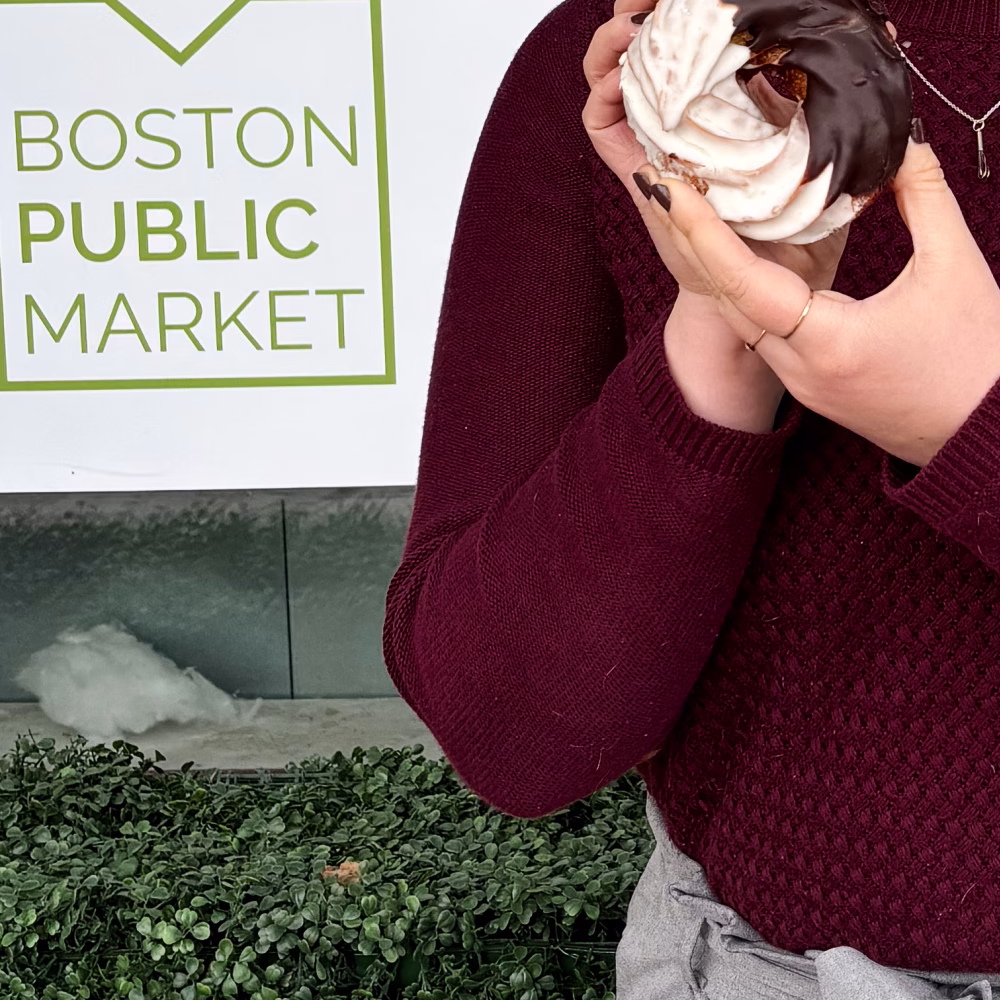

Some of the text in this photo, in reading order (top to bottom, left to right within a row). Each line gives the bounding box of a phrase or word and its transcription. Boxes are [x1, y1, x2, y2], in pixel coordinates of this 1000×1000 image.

[14, 106, 358, 171] BOSTON
[18, 198, 319, 263] PUBLIC
[25, 289, 365, 354] MARKET
